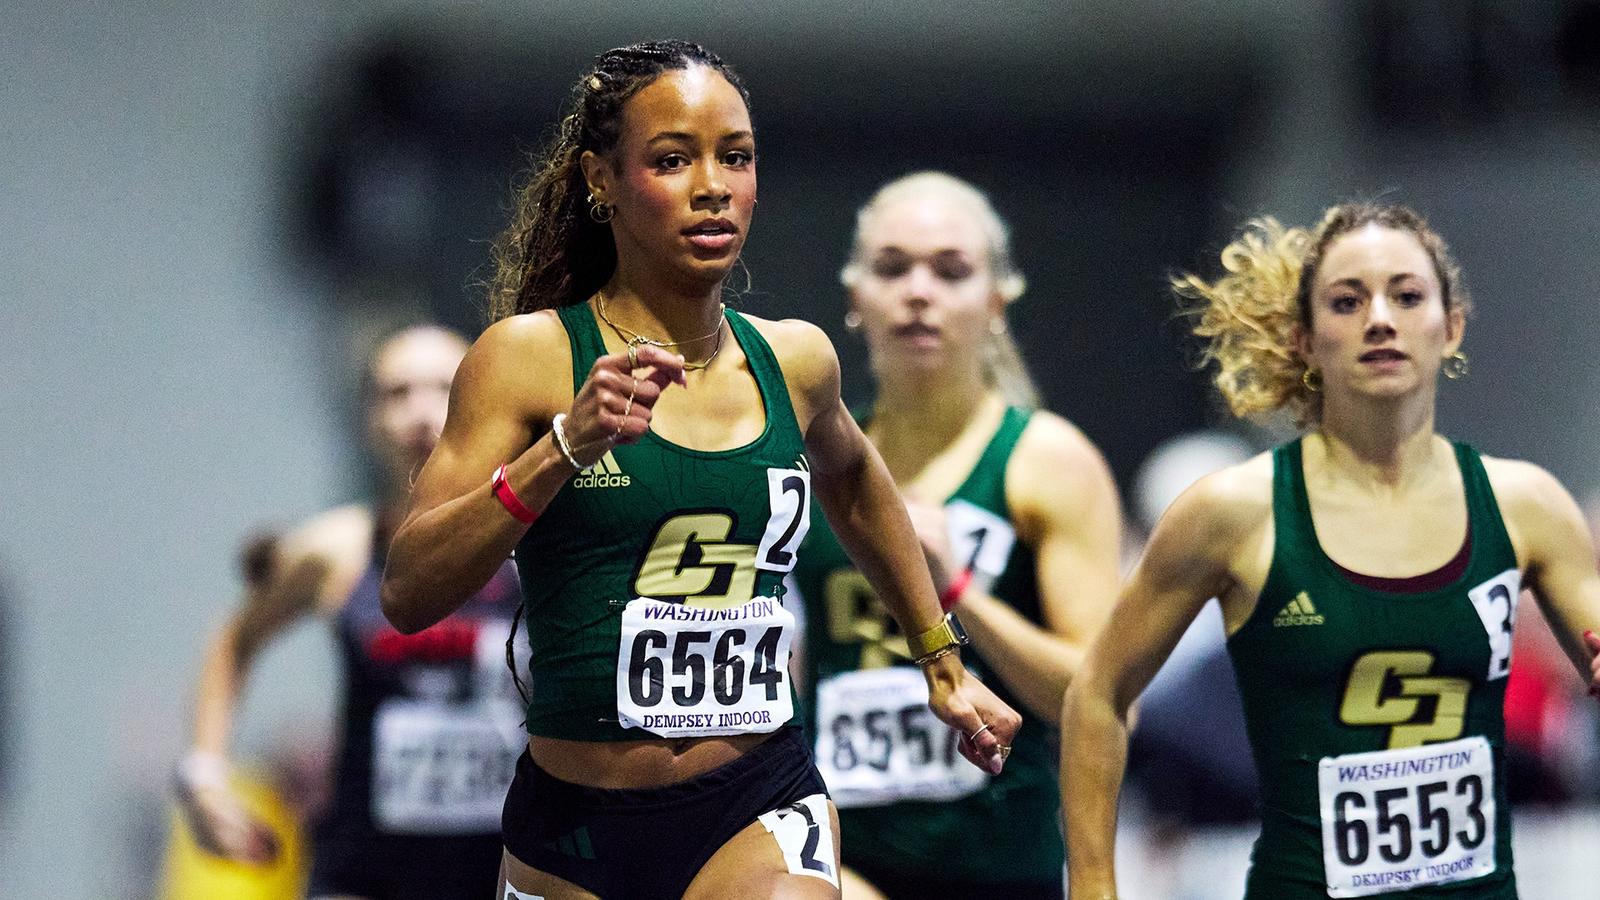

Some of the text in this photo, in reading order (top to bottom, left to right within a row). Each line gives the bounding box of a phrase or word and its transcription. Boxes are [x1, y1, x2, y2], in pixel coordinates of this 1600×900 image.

[573, 473, 631, 488] adidas
[765, 476, 805, 566] 2
[1273, 615, 1325, 627] adidas
[628, 626, 784, 707] 6564
[643, 710, 772, 729] DEMPSEY INDOOR
[1338, 751, 1473, 783] WASHINGTON
[1333, 774, 1487, 867] 6553
[775, 802, 833, 878] 2
[1352, 868, 1421, 888] DEMPSEY
[1426, 856, 1474, 880] INDOOR
